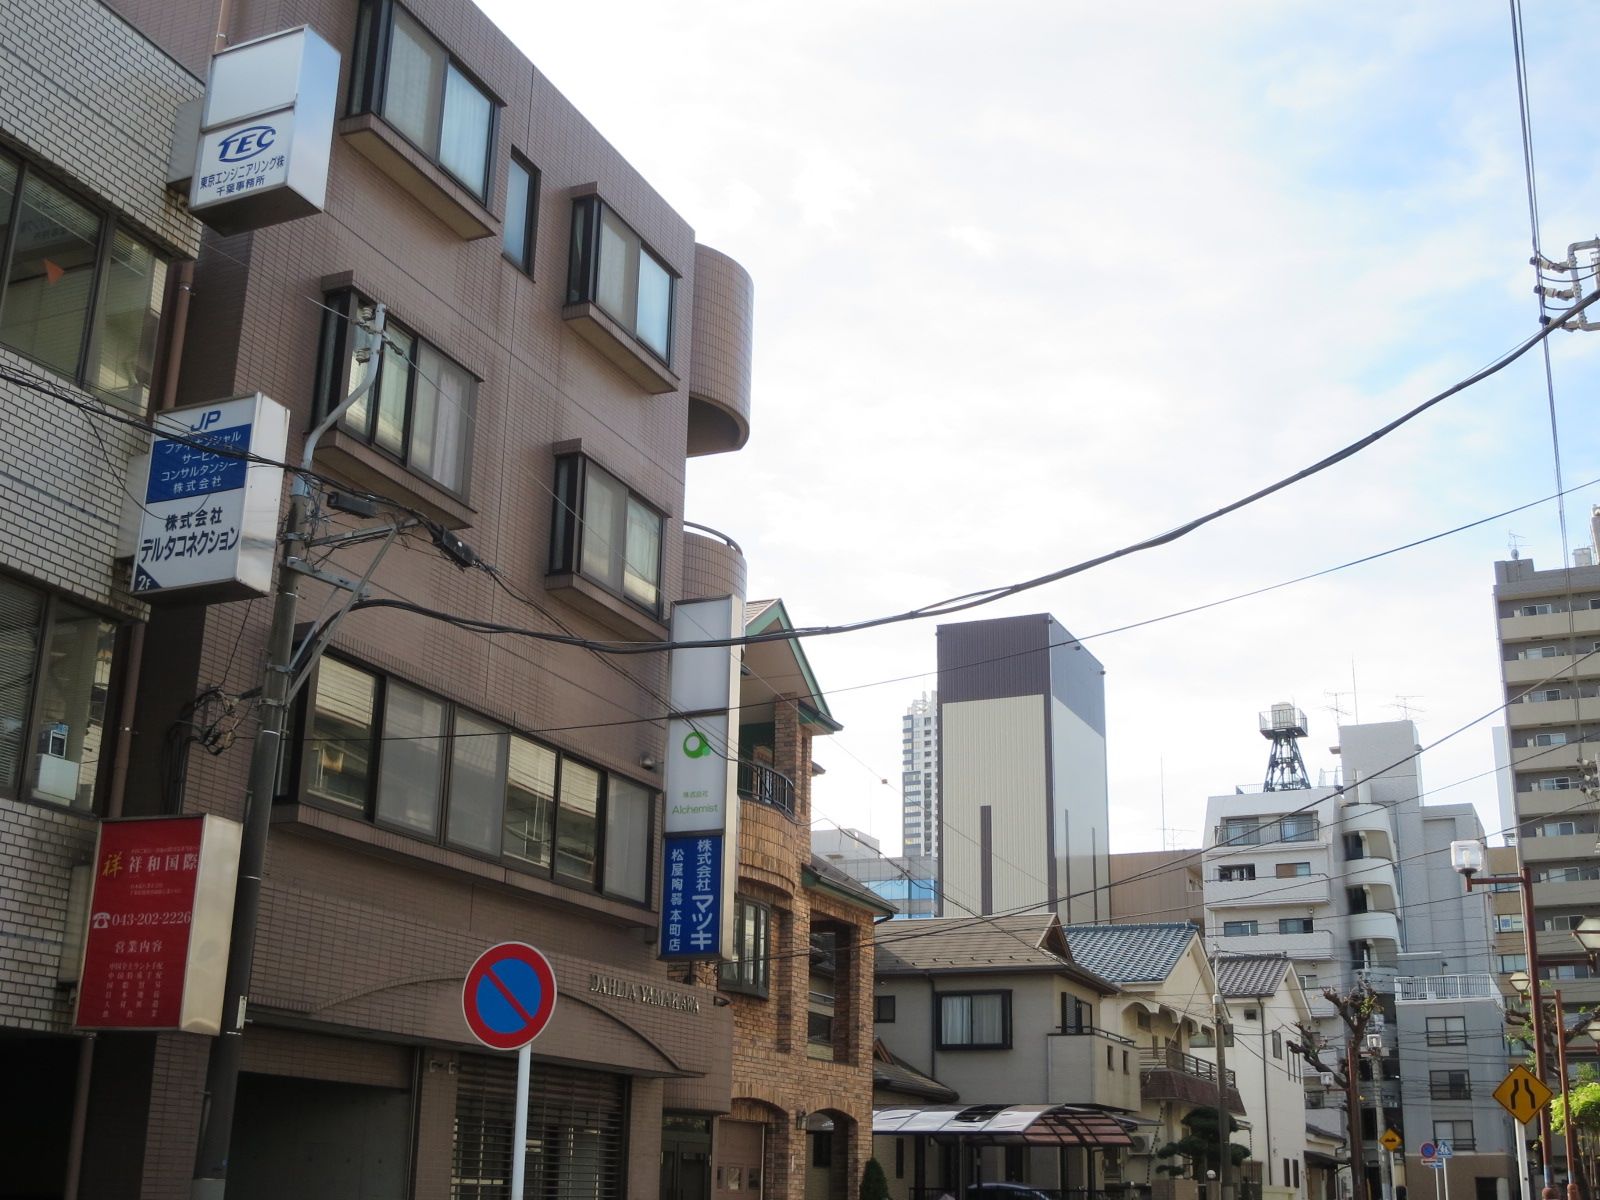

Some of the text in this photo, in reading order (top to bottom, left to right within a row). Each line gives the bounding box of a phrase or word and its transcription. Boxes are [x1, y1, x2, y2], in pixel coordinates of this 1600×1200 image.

[217, 126, 277, 163] TEC
[216, 175, 265, 196] 千葉事務所
[190, 410, 222, 432] JP
[161, 461, 238, 482] コンサルタンシー
[173, 475, 222, 494] 株式会社
[165, 506, 223, 532] 株式会社
[141, 527, 240, 564] デルタコネクション
[137, 575, 151, 591] 2F
[671, 803, 719, 815] Alchemist
[112, 911, 192, 927] 043-202-2226
[590, 973, 636, 1001] DAHLIA
